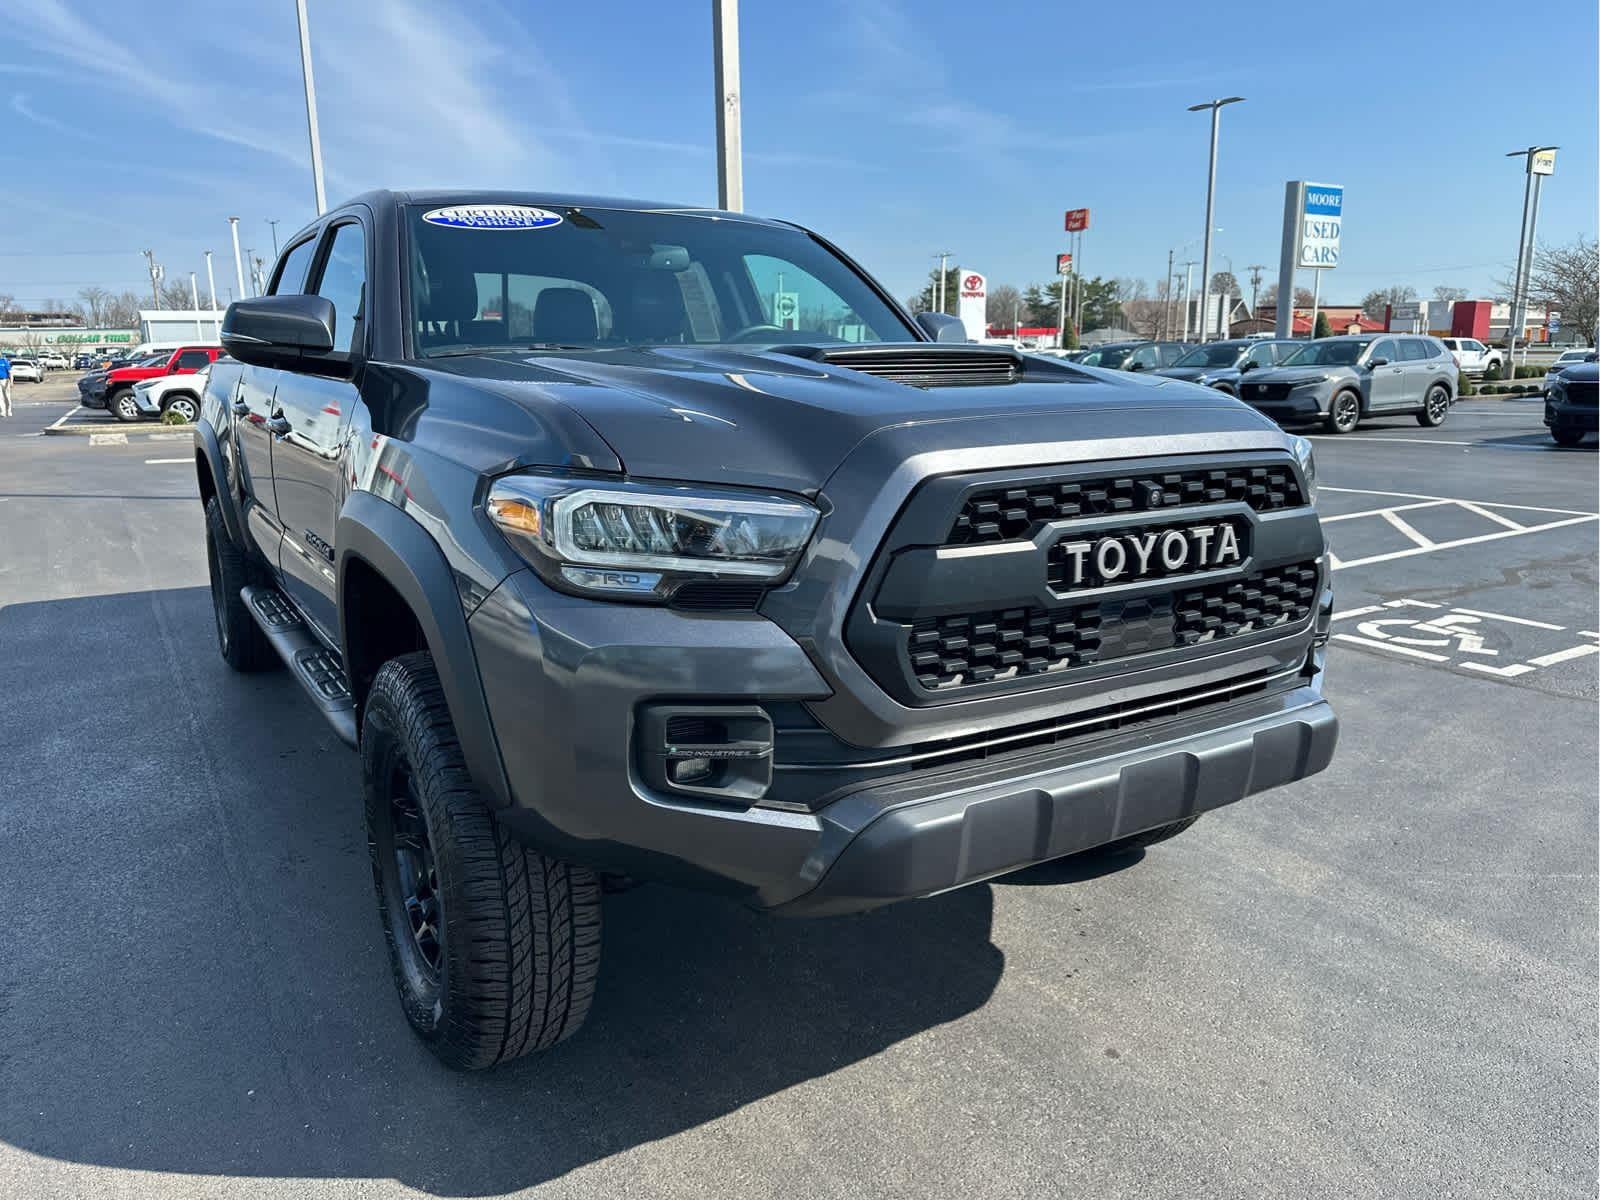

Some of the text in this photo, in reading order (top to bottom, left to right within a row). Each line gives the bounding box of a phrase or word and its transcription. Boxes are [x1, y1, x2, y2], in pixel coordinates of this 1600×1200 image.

[1308, 192, 1342, 207] MOORE
[440, 209, 545, 218] CERTIFIED
[1304, 221, 1340, 239] USED
[1302, 246, 1338, 263] CARS
[1064, 524, 1240, 583] TOYOTA
[584, 570, 641, 586] TRD
